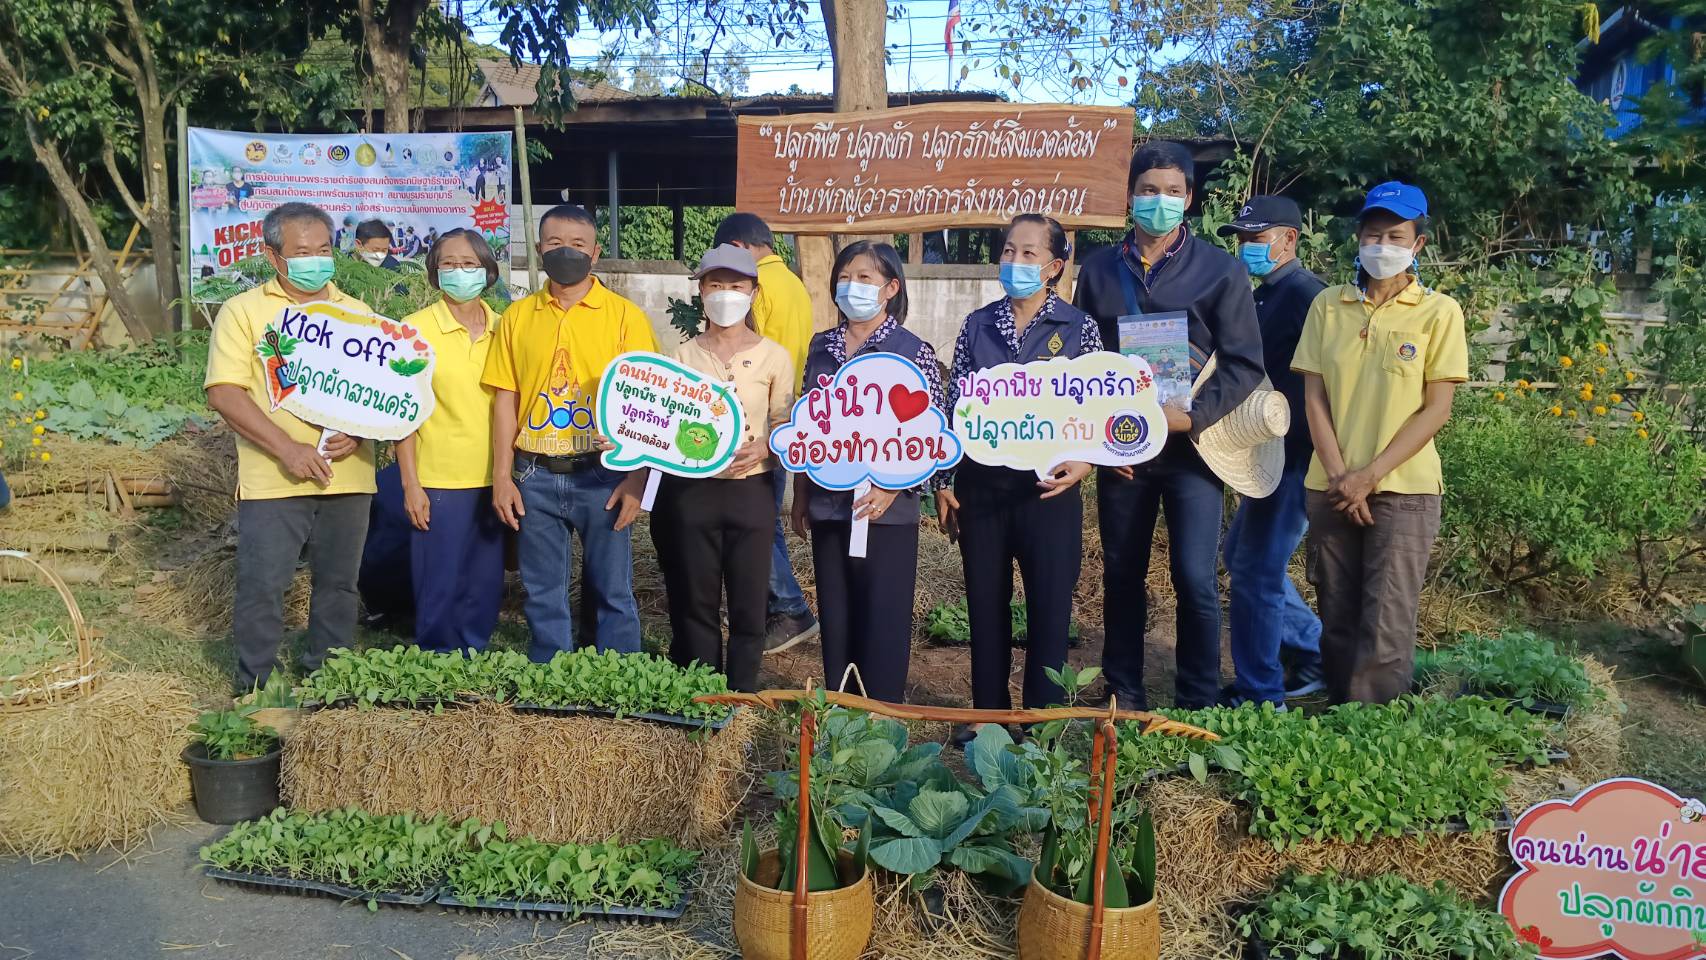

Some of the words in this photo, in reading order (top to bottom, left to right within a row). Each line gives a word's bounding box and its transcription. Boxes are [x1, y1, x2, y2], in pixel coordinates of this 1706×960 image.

[846, 121, 913, 172] ปลูกผัก
[779, 171, 1087, 225] บ้านพักผู้ว่าราชการจังหวัดน่าน
[214, 220, 264, 246] KICK
[281, 308, 333, 349] Kick
[343, 337, 396, 367] off
[288, 359, 419, 422] ปลูกผักสวนครัว
[615, 380, 657, 403] ปลูกพืช
[661, 396, 701, 418] ปลูกผัก
[619, 364, 668, 389] คนน่าน
[673, 377, 712, 403] ร่วมใจ
[1051, 371, 1135, 404] ปลูกรัก
[622, 403, 672, 429] ปลูกรักษ์
[808, 375, 883, 435] ผู้นำ
[617, 421, 670, 450] สิ่งแวดล้อม
[965, 414, 1054, 448] ปลูกผัก
[1062, 417, 1094, 440] กับ
